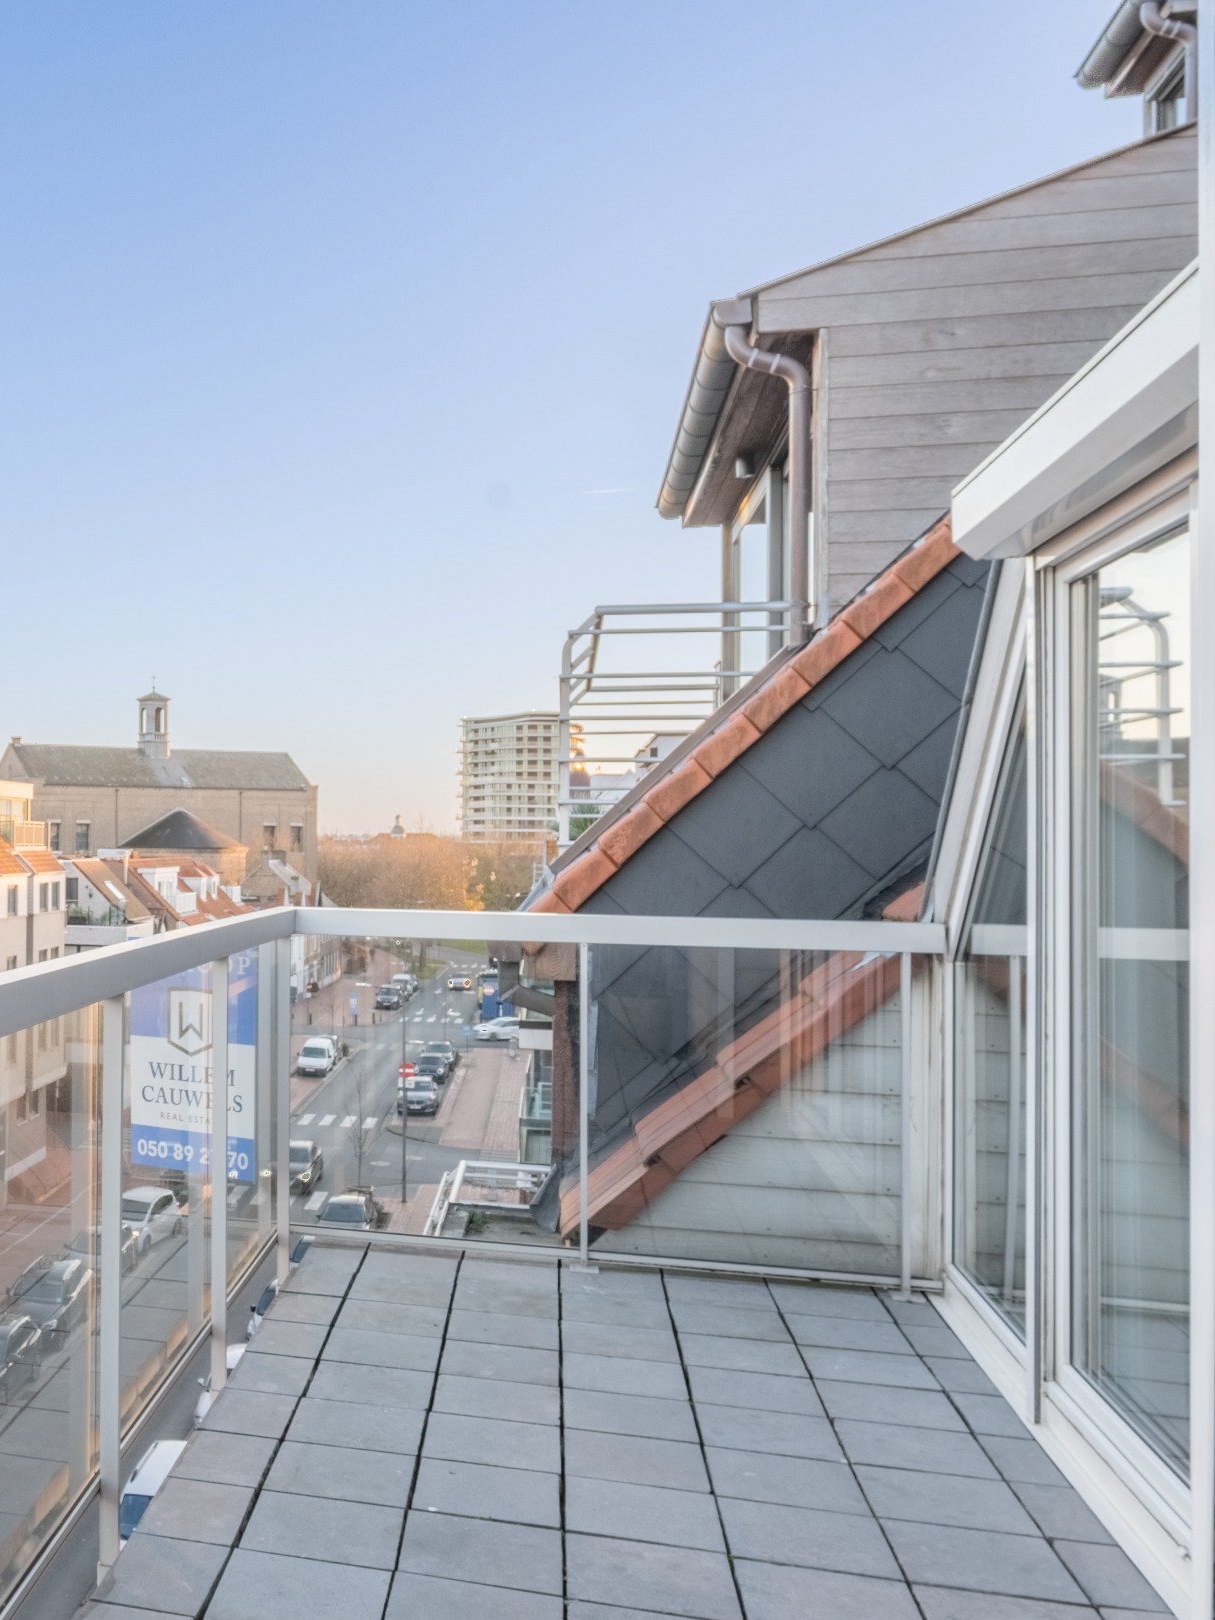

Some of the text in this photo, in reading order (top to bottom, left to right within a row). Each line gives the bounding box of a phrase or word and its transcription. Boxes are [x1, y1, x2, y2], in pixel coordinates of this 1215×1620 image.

[141, 1085, 243, 1113] CAUWES
[160, 1111, 212, 1125] REAL ESTA
[137, 1138, 168, 1159] 050
[173, 1143, 194, 1162] 89
[227, 1151, 249, 1170] 70
